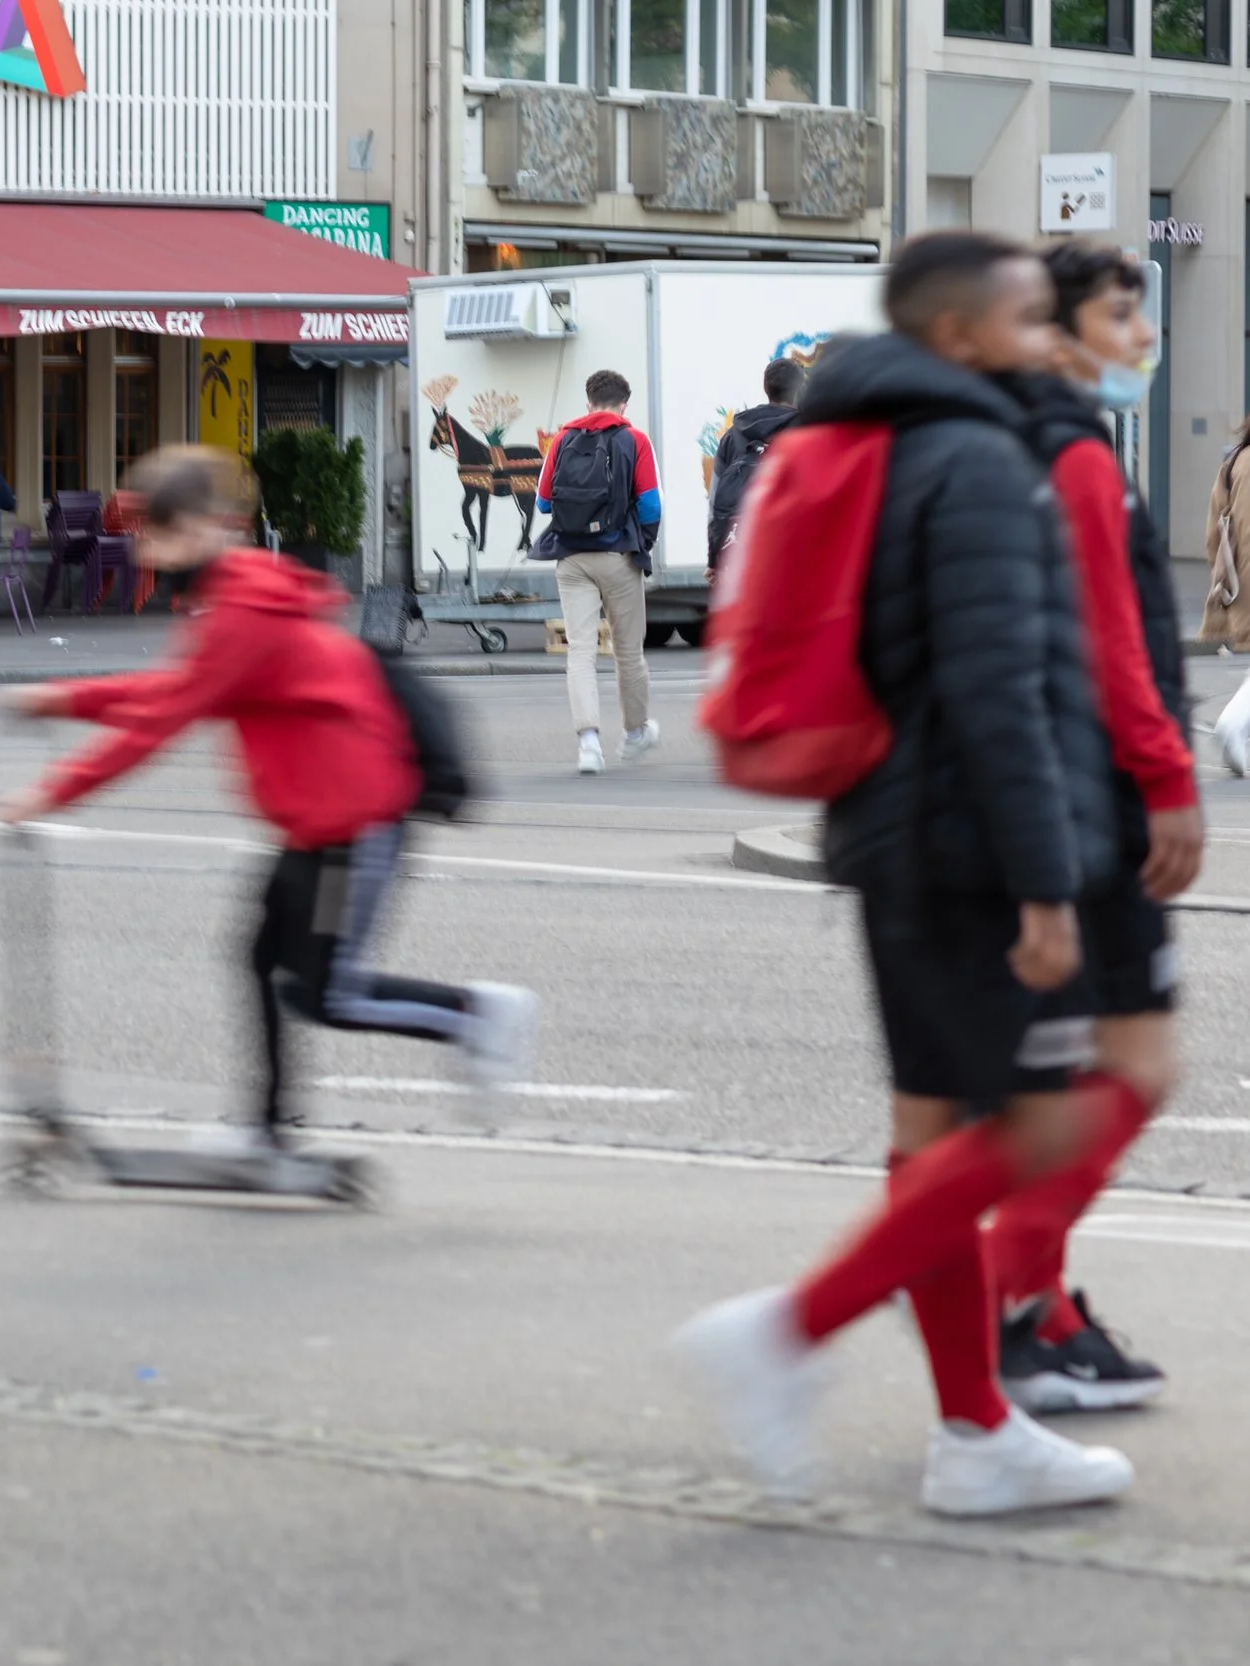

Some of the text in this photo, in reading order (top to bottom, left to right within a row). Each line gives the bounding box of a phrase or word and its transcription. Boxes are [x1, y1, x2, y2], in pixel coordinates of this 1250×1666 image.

[282, 204, 370, 229] DANCING
[19, 309, 65, 335] ZUM
[165, 310, 206, 338] ECK
[299, 312, 343, 341] ZUM
